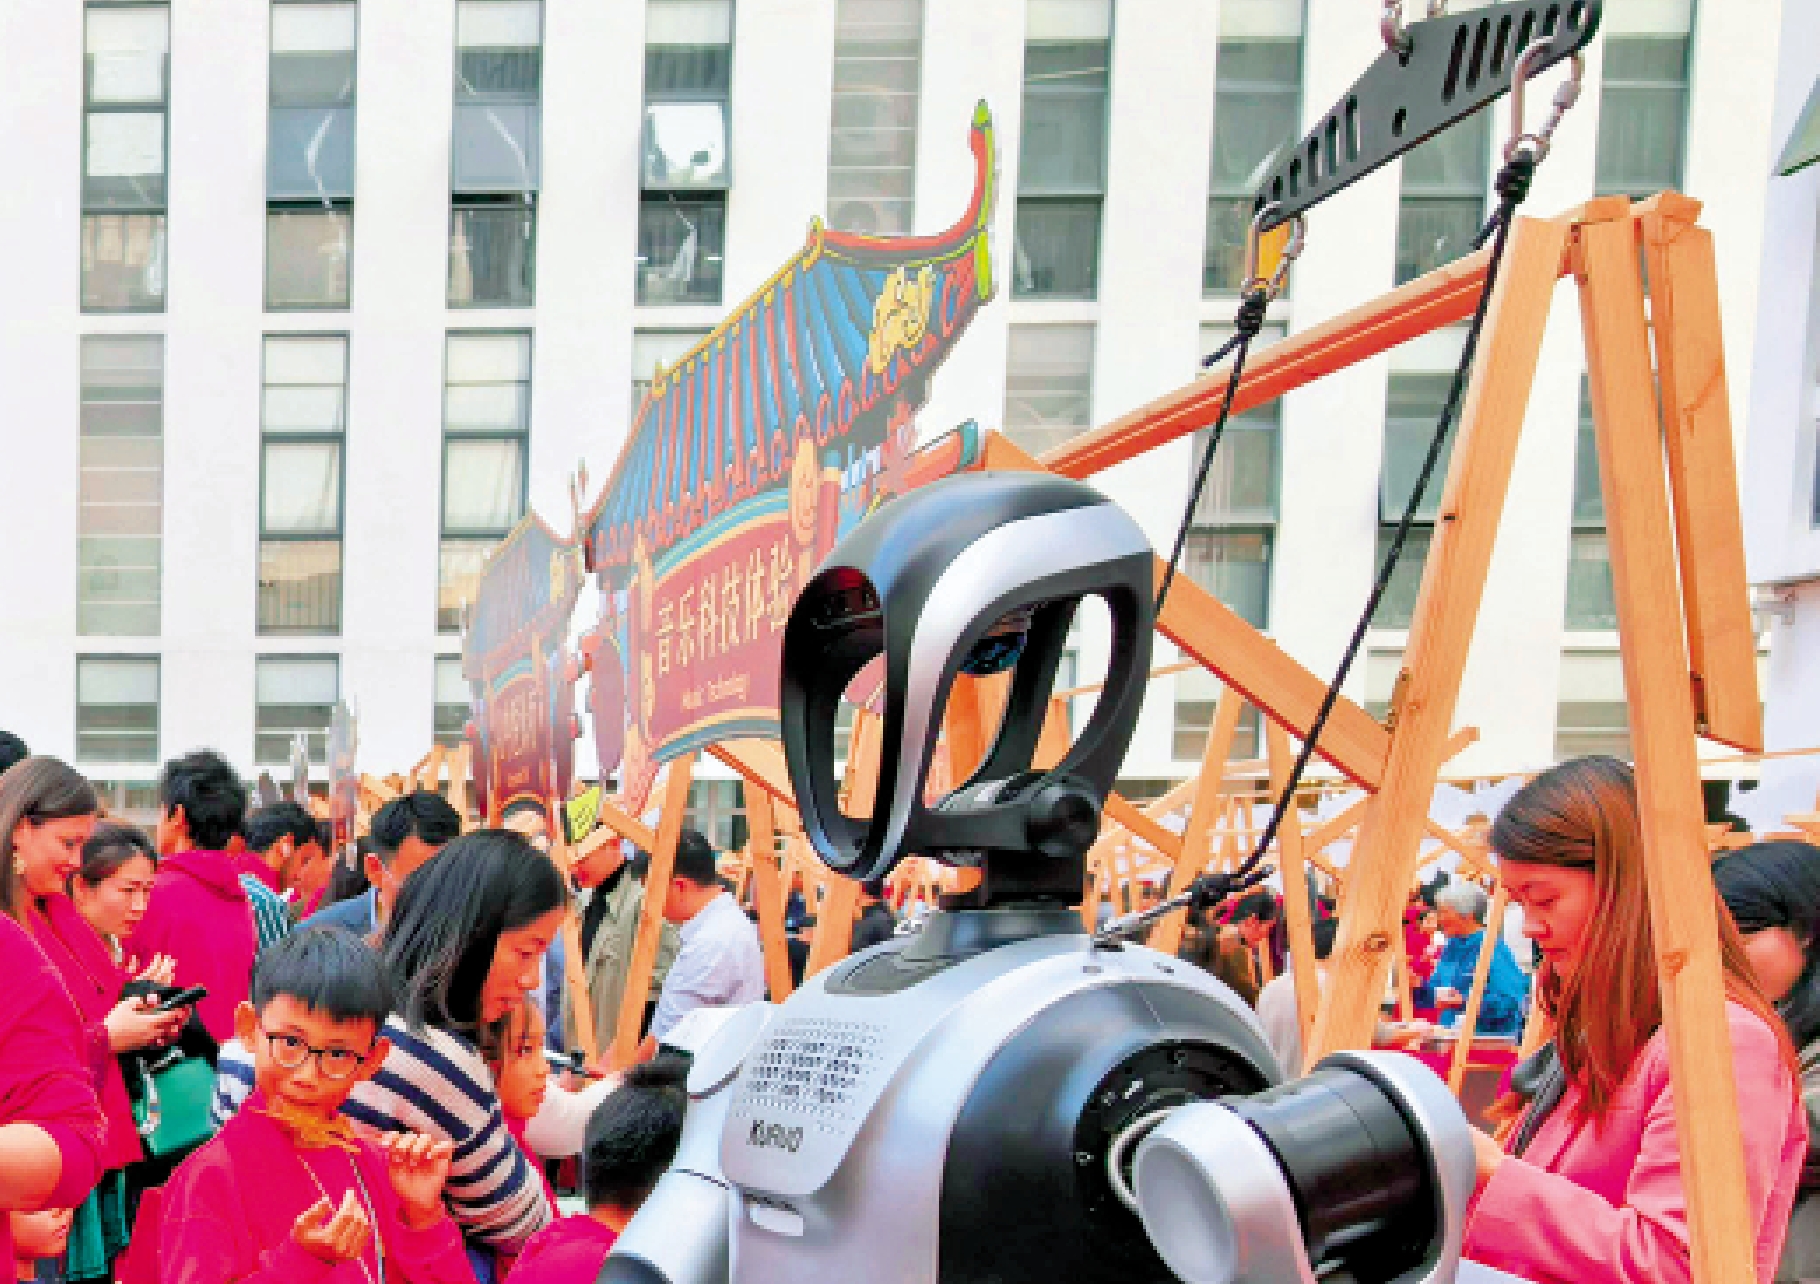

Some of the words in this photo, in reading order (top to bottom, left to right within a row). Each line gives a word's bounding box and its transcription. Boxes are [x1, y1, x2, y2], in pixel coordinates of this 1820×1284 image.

[656, 534, 792, 678] 音乐科技体验
